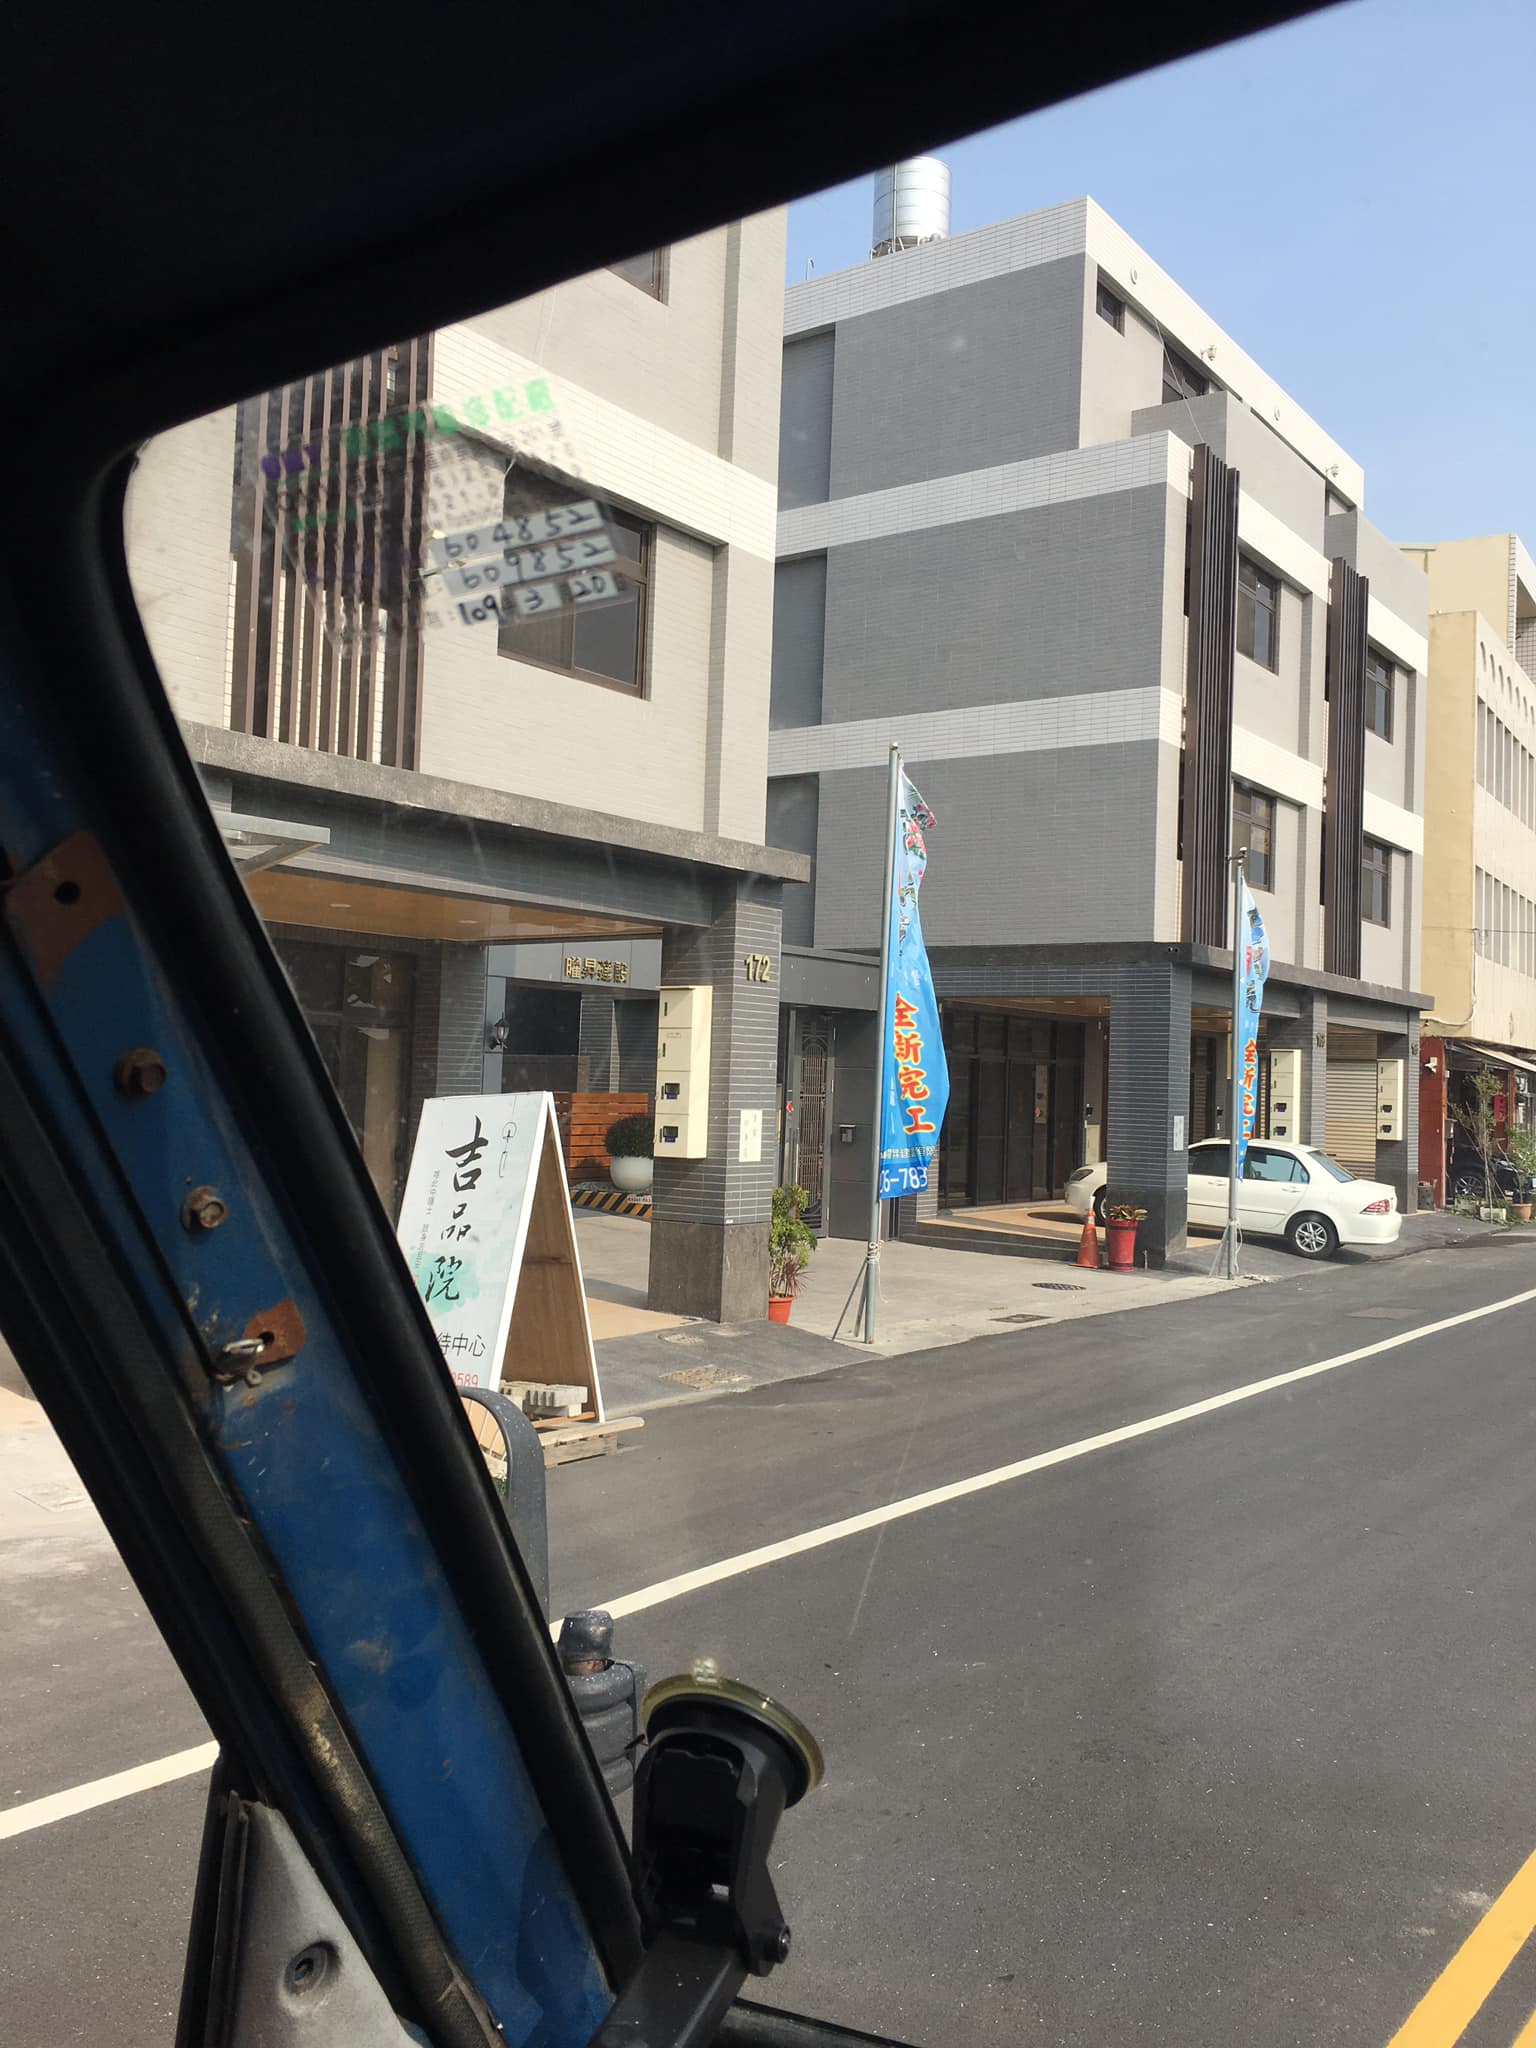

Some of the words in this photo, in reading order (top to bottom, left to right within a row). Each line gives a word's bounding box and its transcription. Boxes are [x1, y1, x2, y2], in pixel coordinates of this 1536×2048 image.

[458, 594, 503, 625] 109
[746, 953, 770, 982] 172
[894, 991, 936, 1135] 全新完工
